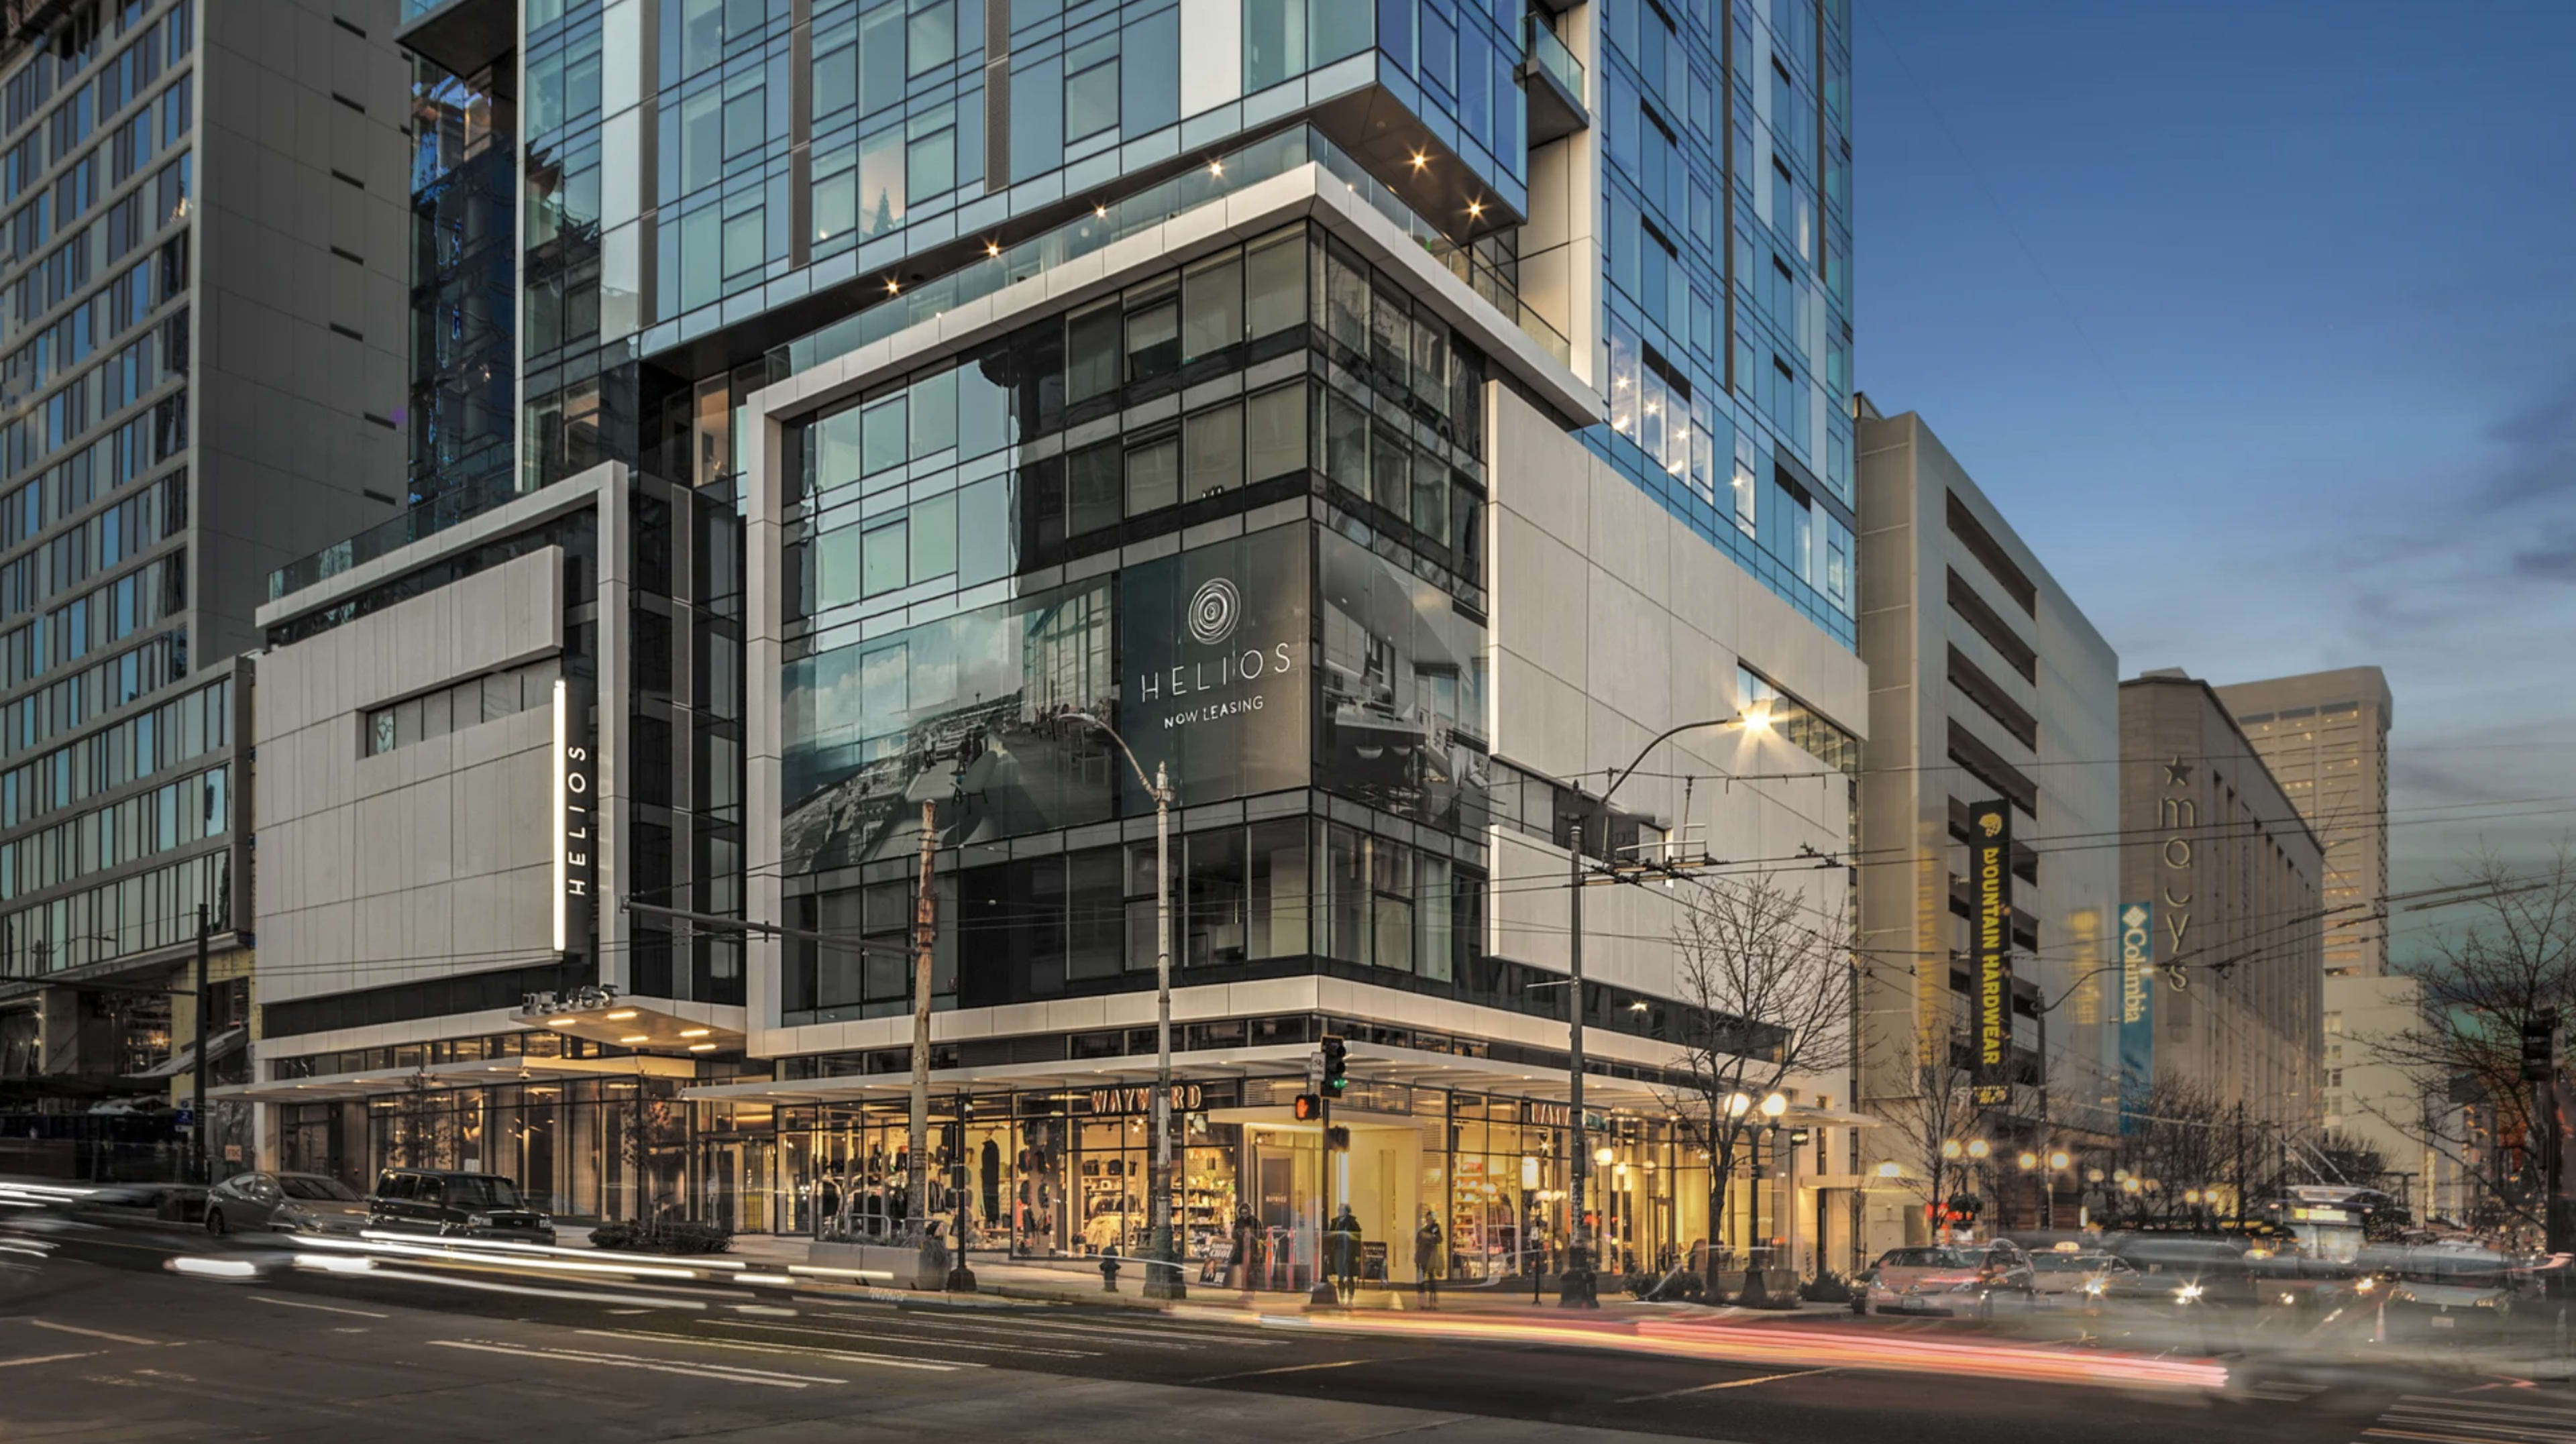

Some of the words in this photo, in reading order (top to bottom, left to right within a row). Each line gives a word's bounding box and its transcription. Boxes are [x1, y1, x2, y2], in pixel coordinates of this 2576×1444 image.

[1141, 642, 1291, 702] HELIOS
[1164, 709, 1199, 729] NOW
[1203, 696, 1263, 722] LEASING
[568, 747, 587, 896] HELIOS
[1982, 846, 2000, 950] MOUNTAIN
[1982, 954, 2000, 1065] HARDWEAR
[2123, 928, 2147, 1024] Columbia
[1091, 1085, 1201, 1114] WAYWRD
